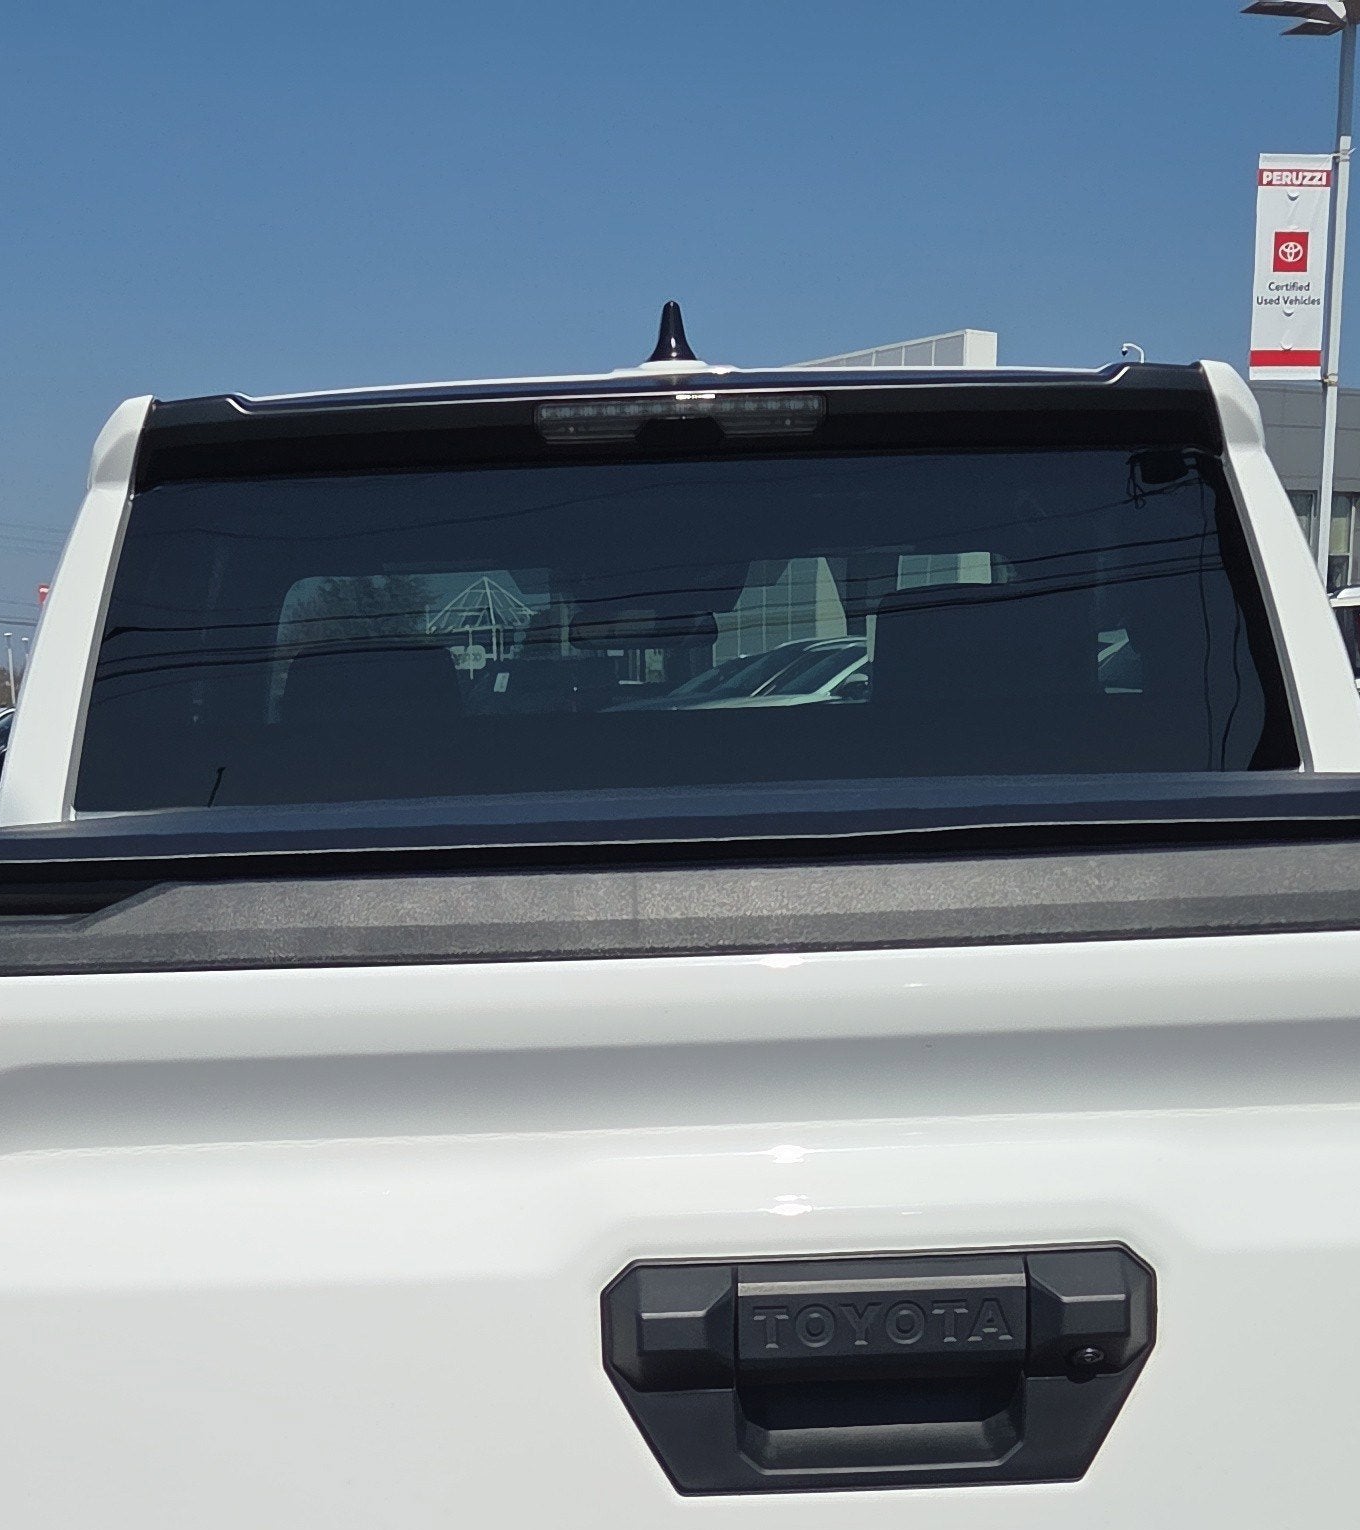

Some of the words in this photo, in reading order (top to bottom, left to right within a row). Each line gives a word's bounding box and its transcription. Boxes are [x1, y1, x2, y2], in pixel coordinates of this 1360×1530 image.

[1262, 171, 1327, 185] PERUZZI
[1268, 281, 1310, 292] Certified
[1256, 296, 1280, 306] Used
[1282, 296, 1321, 306] Vehicles
[752, 1298, 1014, 1349] TOYOTA
